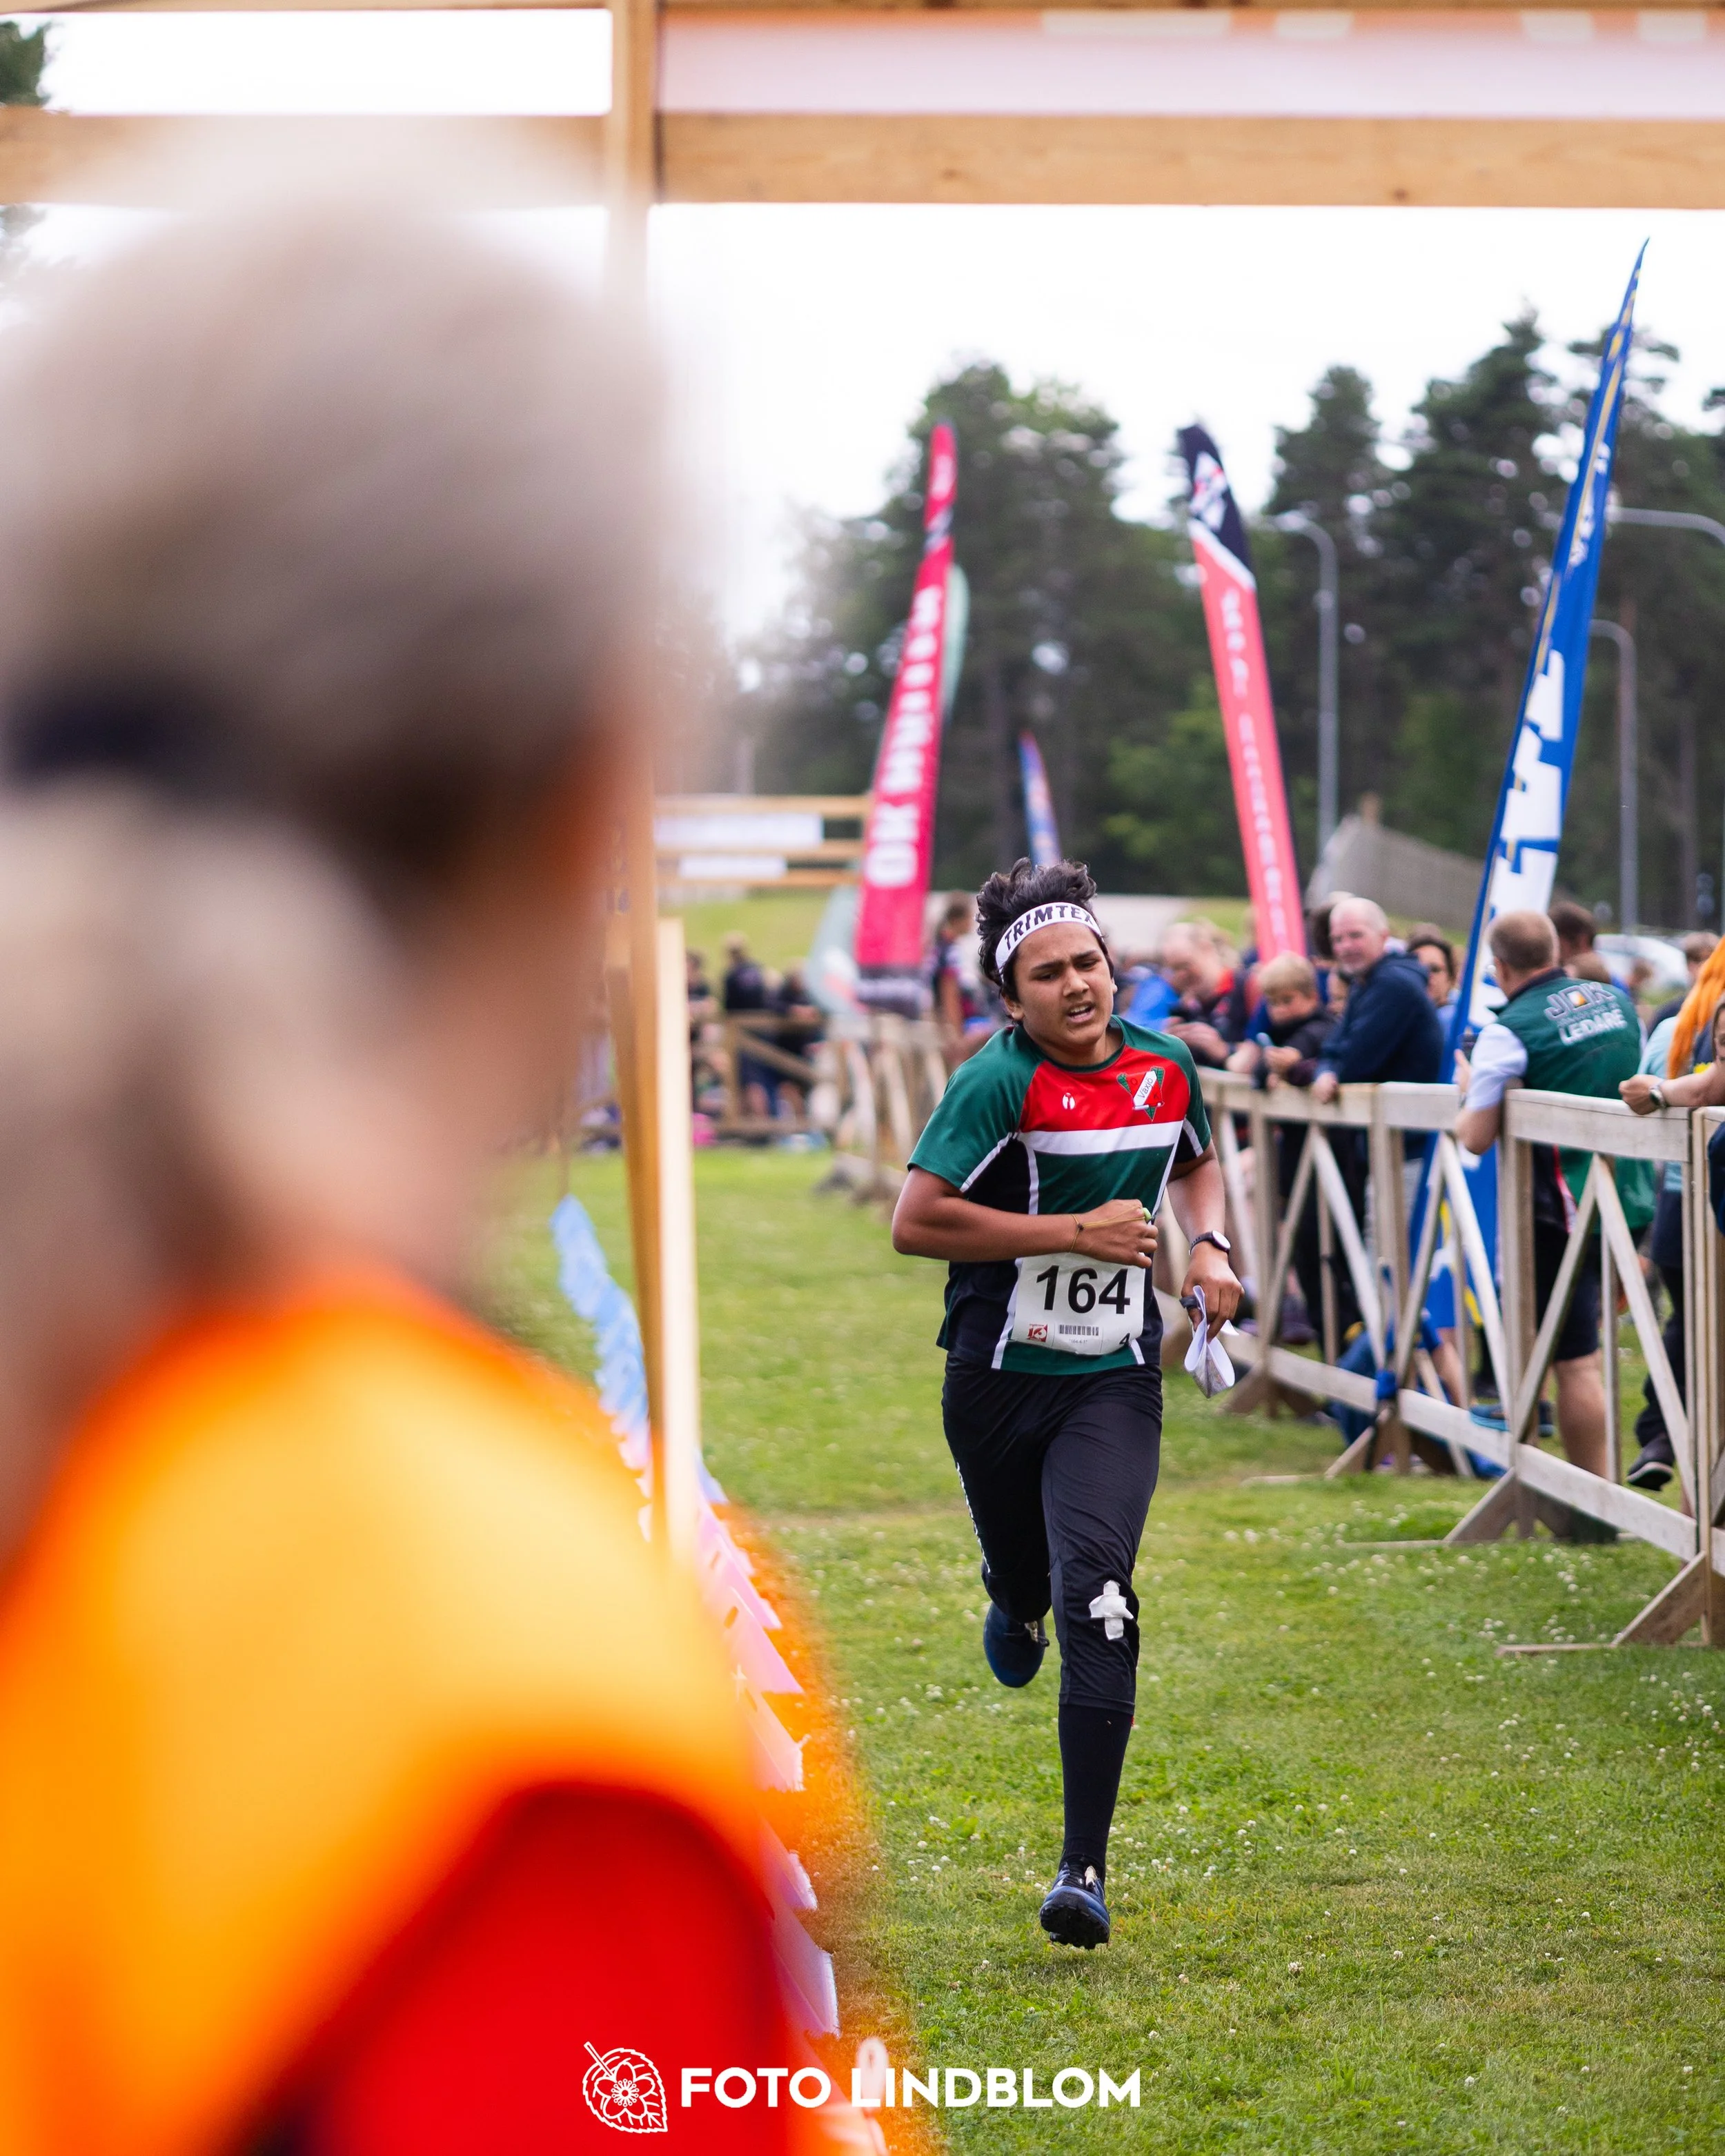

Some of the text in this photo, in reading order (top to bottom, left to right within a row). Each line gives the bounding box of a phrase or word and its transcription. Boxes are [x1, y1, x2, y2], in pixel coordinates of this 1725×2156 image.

[1005, 905, 1094, 951] TRIMTEX
[1559, 1009, 1628, 1045] LEDARE
[1036, 1265, 1131, 1315] 164
[1119, 1332, 1131, 1346] 4
